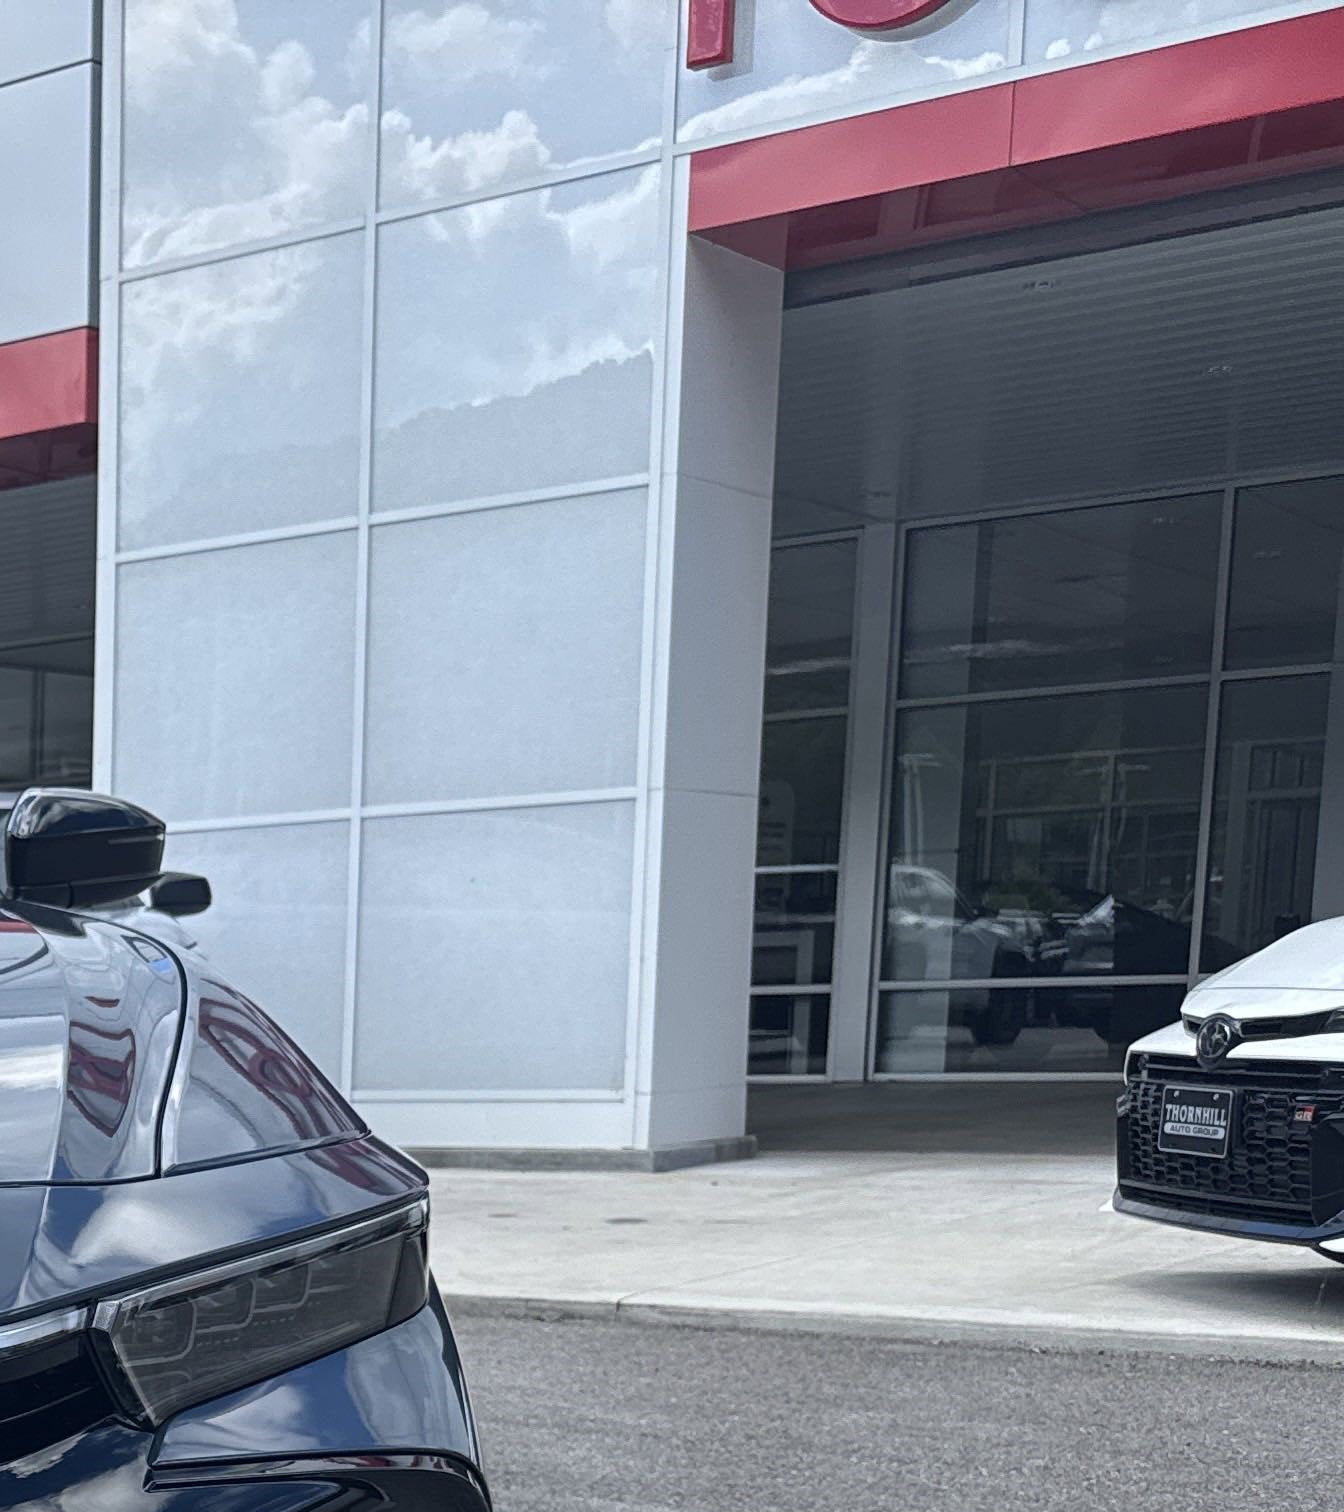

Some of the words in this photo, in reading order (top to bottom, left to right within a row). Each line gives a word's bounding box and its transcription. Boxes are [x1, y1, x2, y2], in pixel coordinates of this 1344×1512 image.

[1165, 1104, 1226, 1127] THORNHILL
[1169, 1124, 1191, 1134] AUTO
[1192, 1126, 1219, 1136] GROUP
